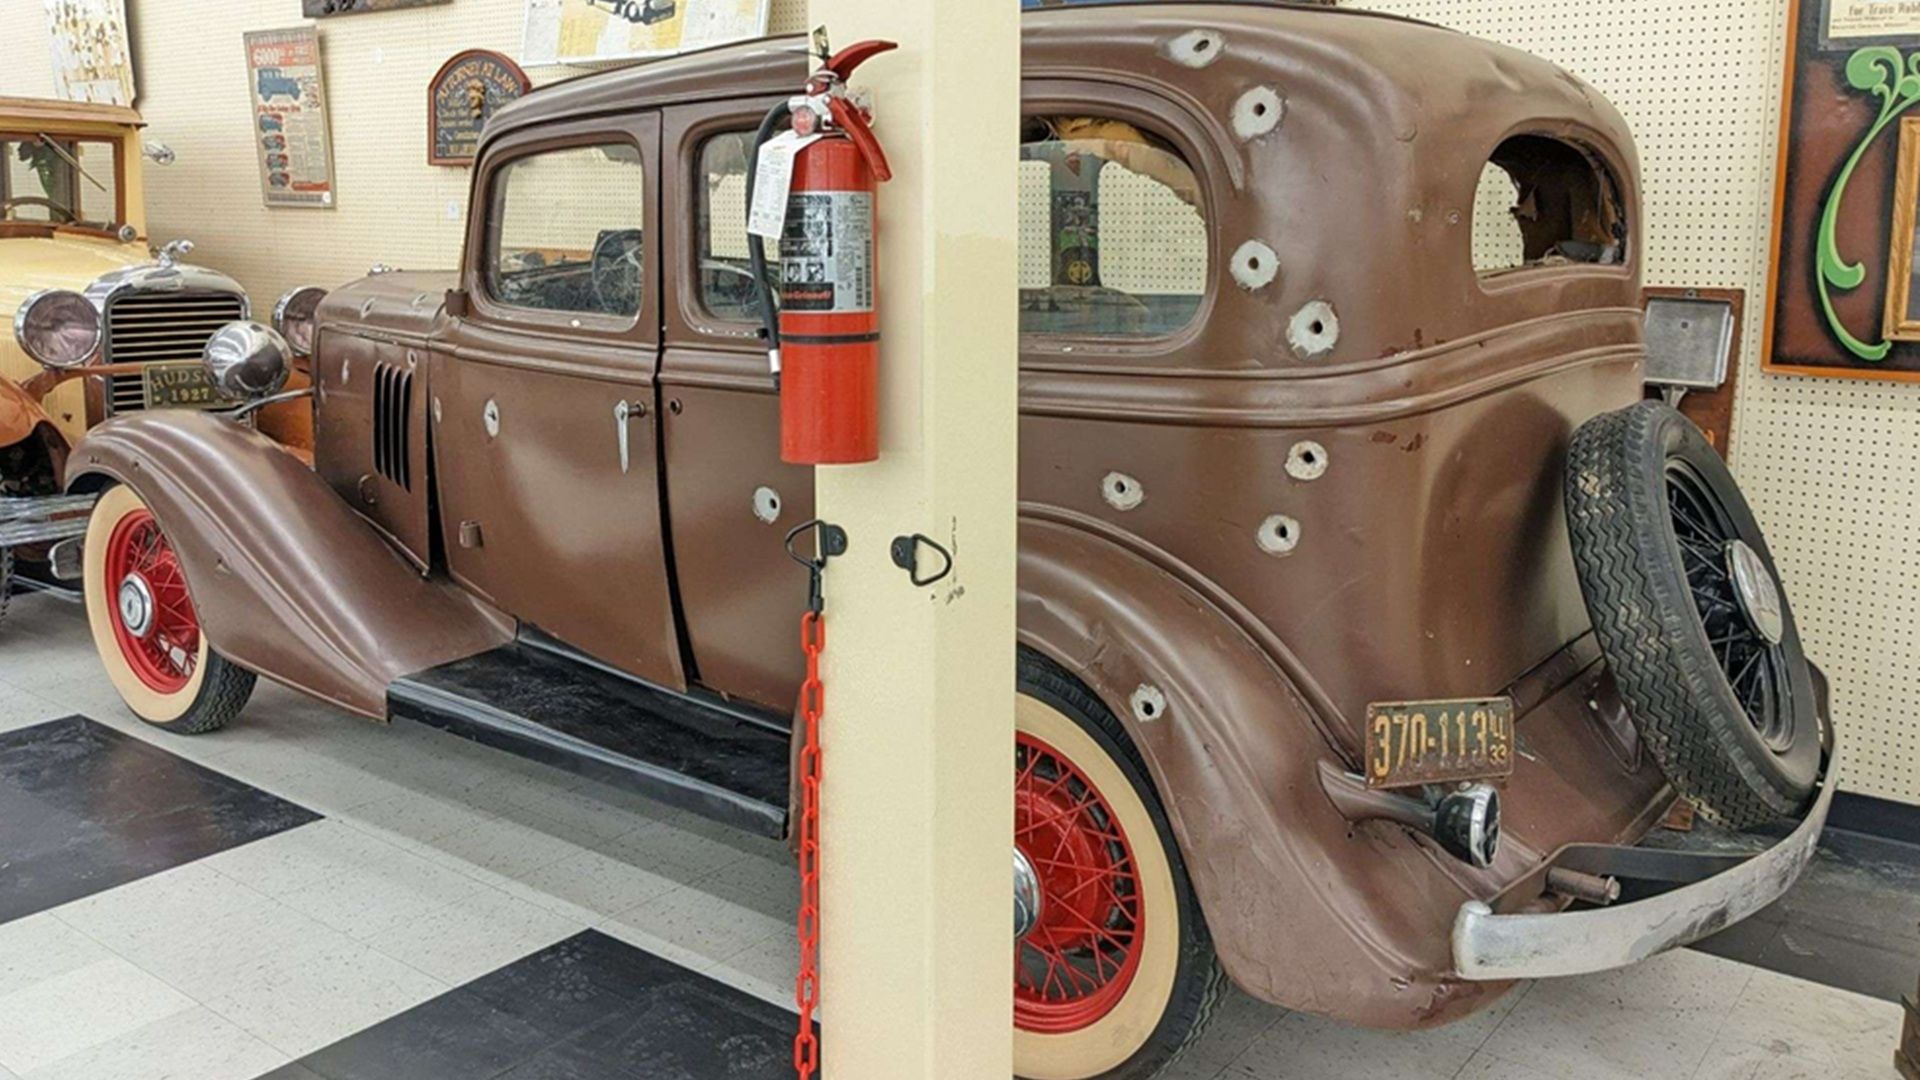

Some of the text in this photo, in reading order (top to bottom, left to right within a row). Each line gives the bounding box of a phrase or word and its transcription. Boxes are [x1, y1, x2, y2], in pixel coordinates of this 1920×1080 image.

[481, 62, 495, 77] AT
[494, 67, 517, 94] LAW
[171, 387, 209, 402] 1927
[1373, 710, 1487, 778] 370-113
